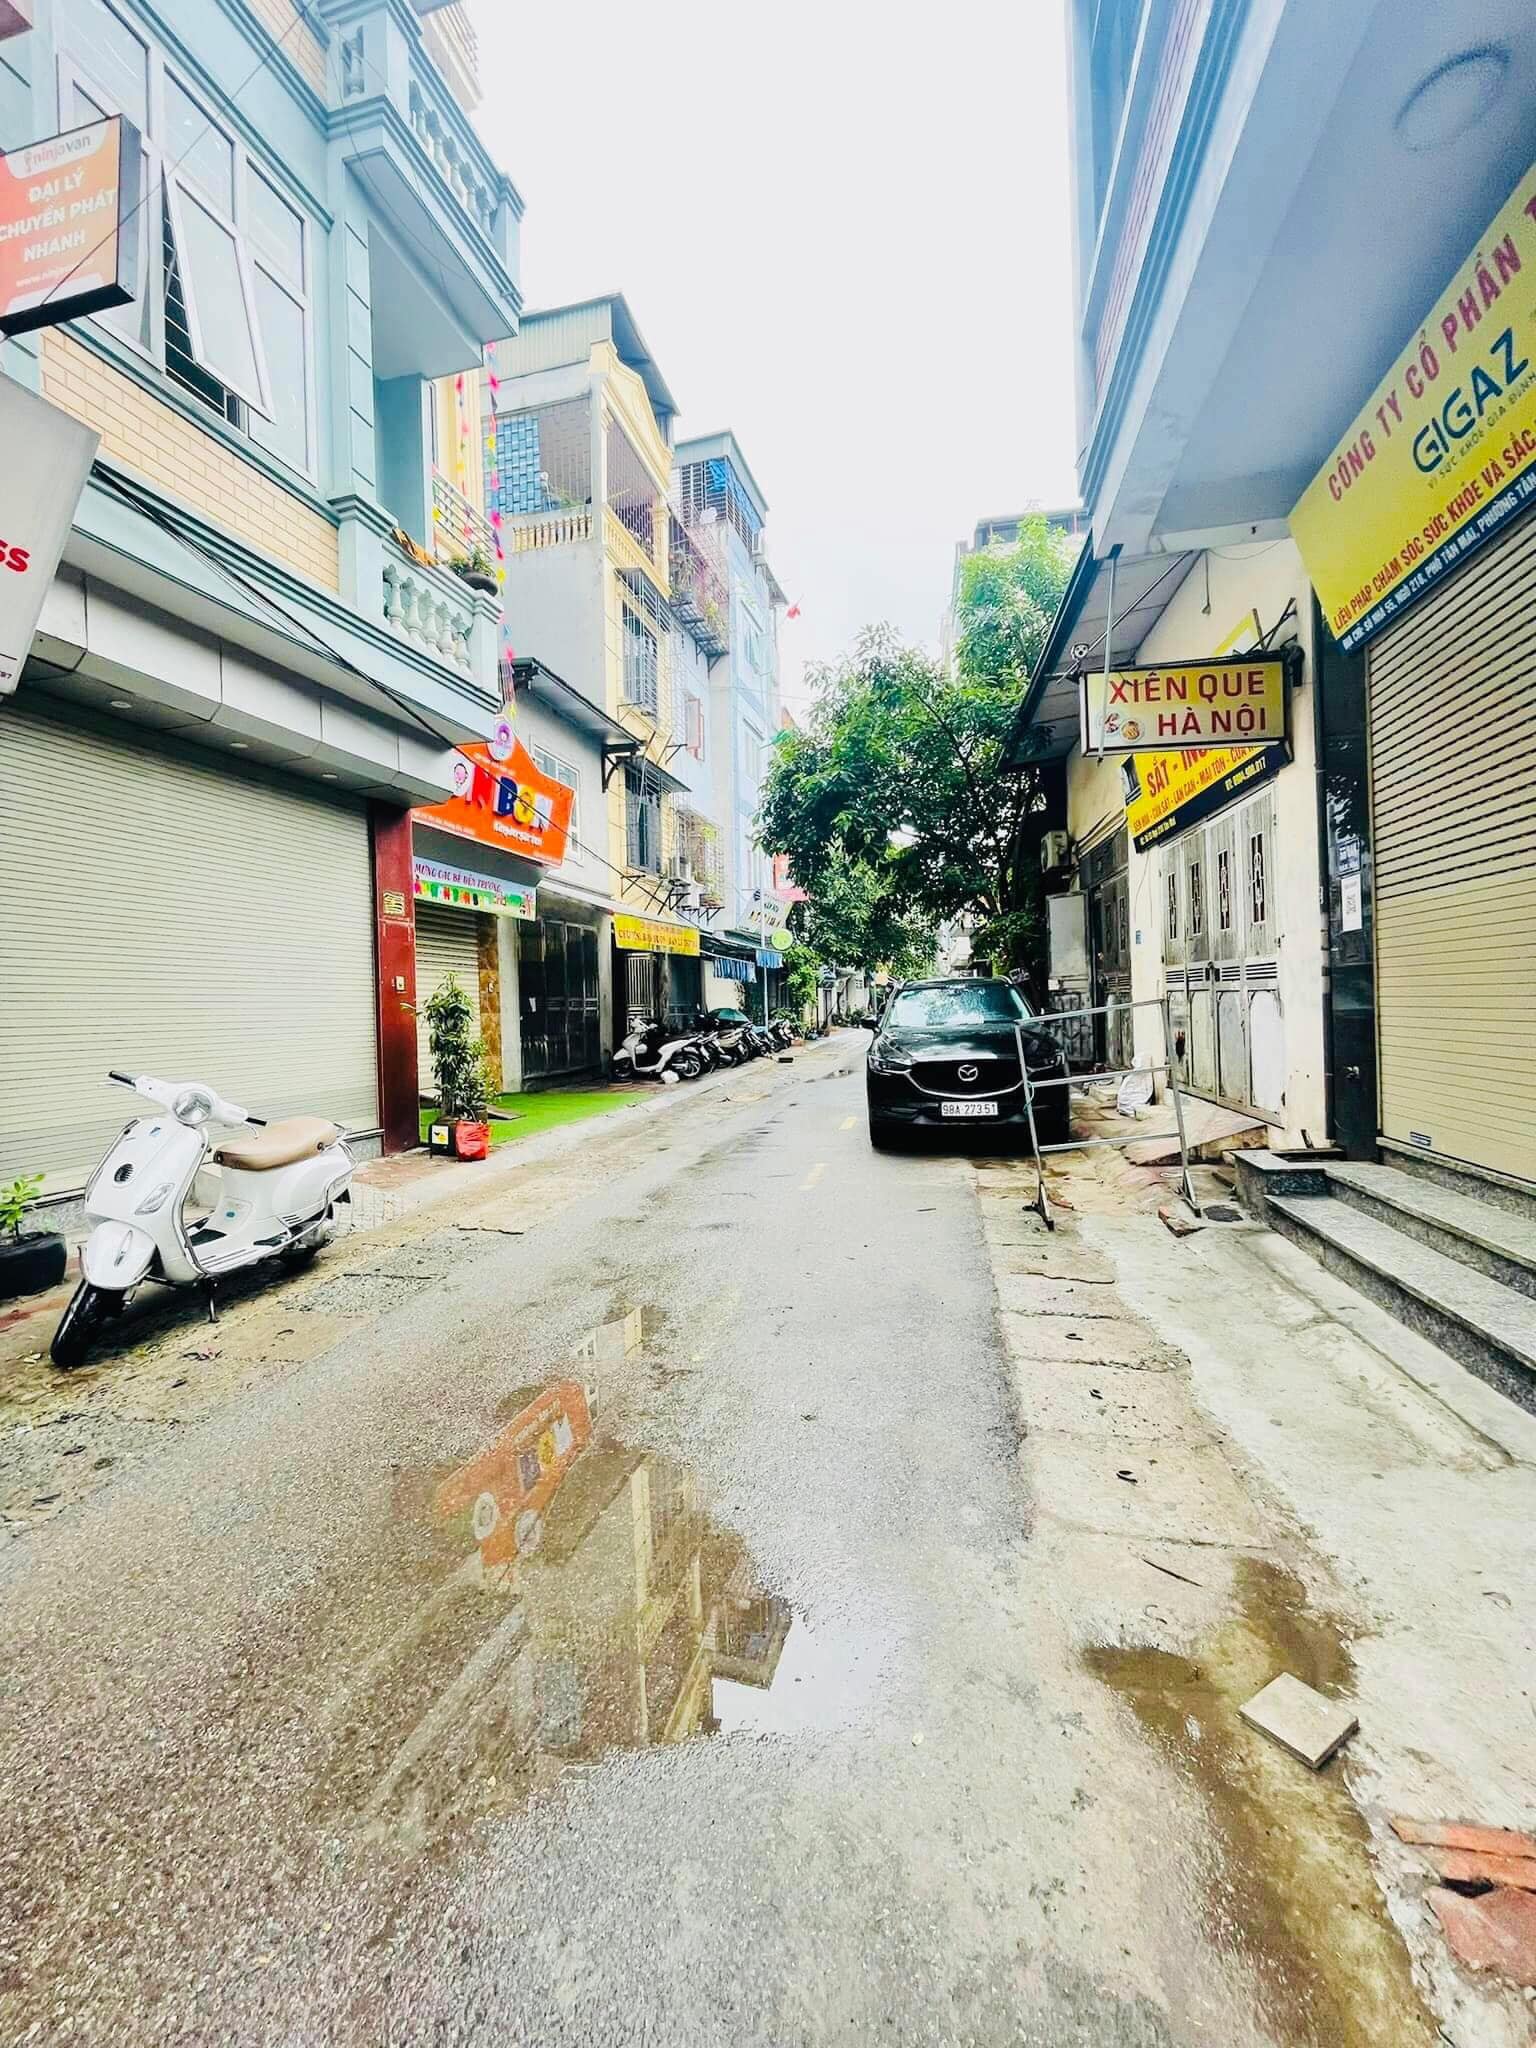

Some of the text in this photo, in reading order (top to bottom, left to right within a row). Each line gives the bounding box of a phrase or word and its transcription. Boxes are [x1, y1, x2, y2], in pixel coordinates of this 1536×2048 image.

[28, 168, 85, 204] ĐẠI LÝ
[70, 186, 118, 219] PHÁT
[24, 228, 86, 262] NHANH
[1328, 429, 1377, 502] CÔNG
[1376, 389, 1404, 439] TY
[1441, 233, 1521, 353] PHẦN
[1413, 327, 1529, 473] GIGAZ
[1400, 536, 1424, 566] SÓC
[1423, 513, 1448, 544] SỨC
[1481, 458, 1505, 488] VÀ
[1109, 670, 1265, 704] XIÊN QUE
[1158, 703, 1266, 736] HÀ NỘI
